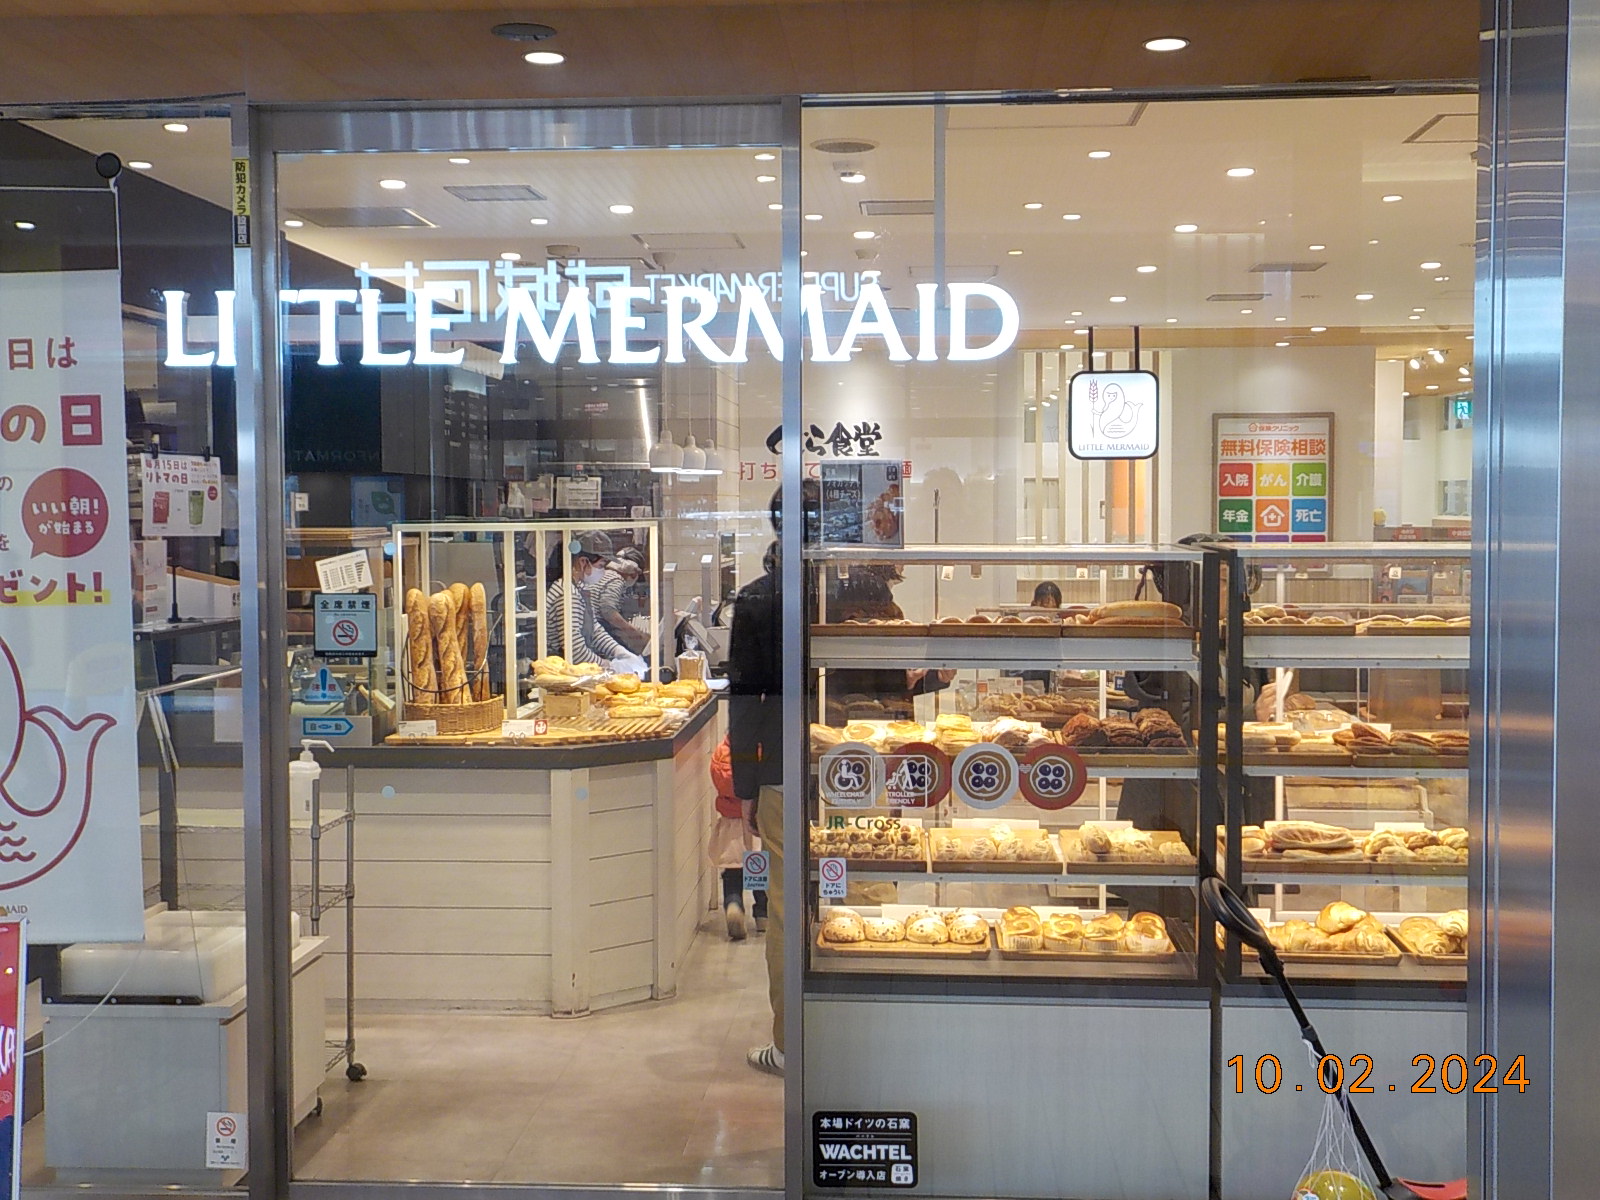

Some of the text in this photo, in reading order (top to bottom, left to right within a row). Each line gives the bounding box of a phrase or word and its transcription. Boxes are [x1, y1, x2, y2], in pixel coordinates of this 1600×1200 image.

[235, 161, 247, 215] 防犯カメラ
[163, 282, 1021, 367] LITLE MERMAID
[0, 394, 103, 446] の日
[1106, 443, 1150, 451] MERMAID
[1221, 438, 1326, 456] 無料保険相談
[145, 459, 188, 470] 毎月15日は
[145, 472, 188, 484] リトマの日
[1223, 473, 1249, 487] 入院
[1260, 473, 1287, 487] がん
[1296, 473, 1322, 487] 介護
[31, 496, 99, 516] いい朝!
[1222, 509, 1249, 523] 年金
[1295, 508, 1322, 523] 死亡
[38, 520, 94, 535] が始まる
[320, 599, 370, 610] 全席禁煙
[820, 1116, 910, 1130] 本場ドイツの石窯
[819, 1143, 912, 1160] WACHTEL
[820, 1169, 886, 1181] オーブン導入店
